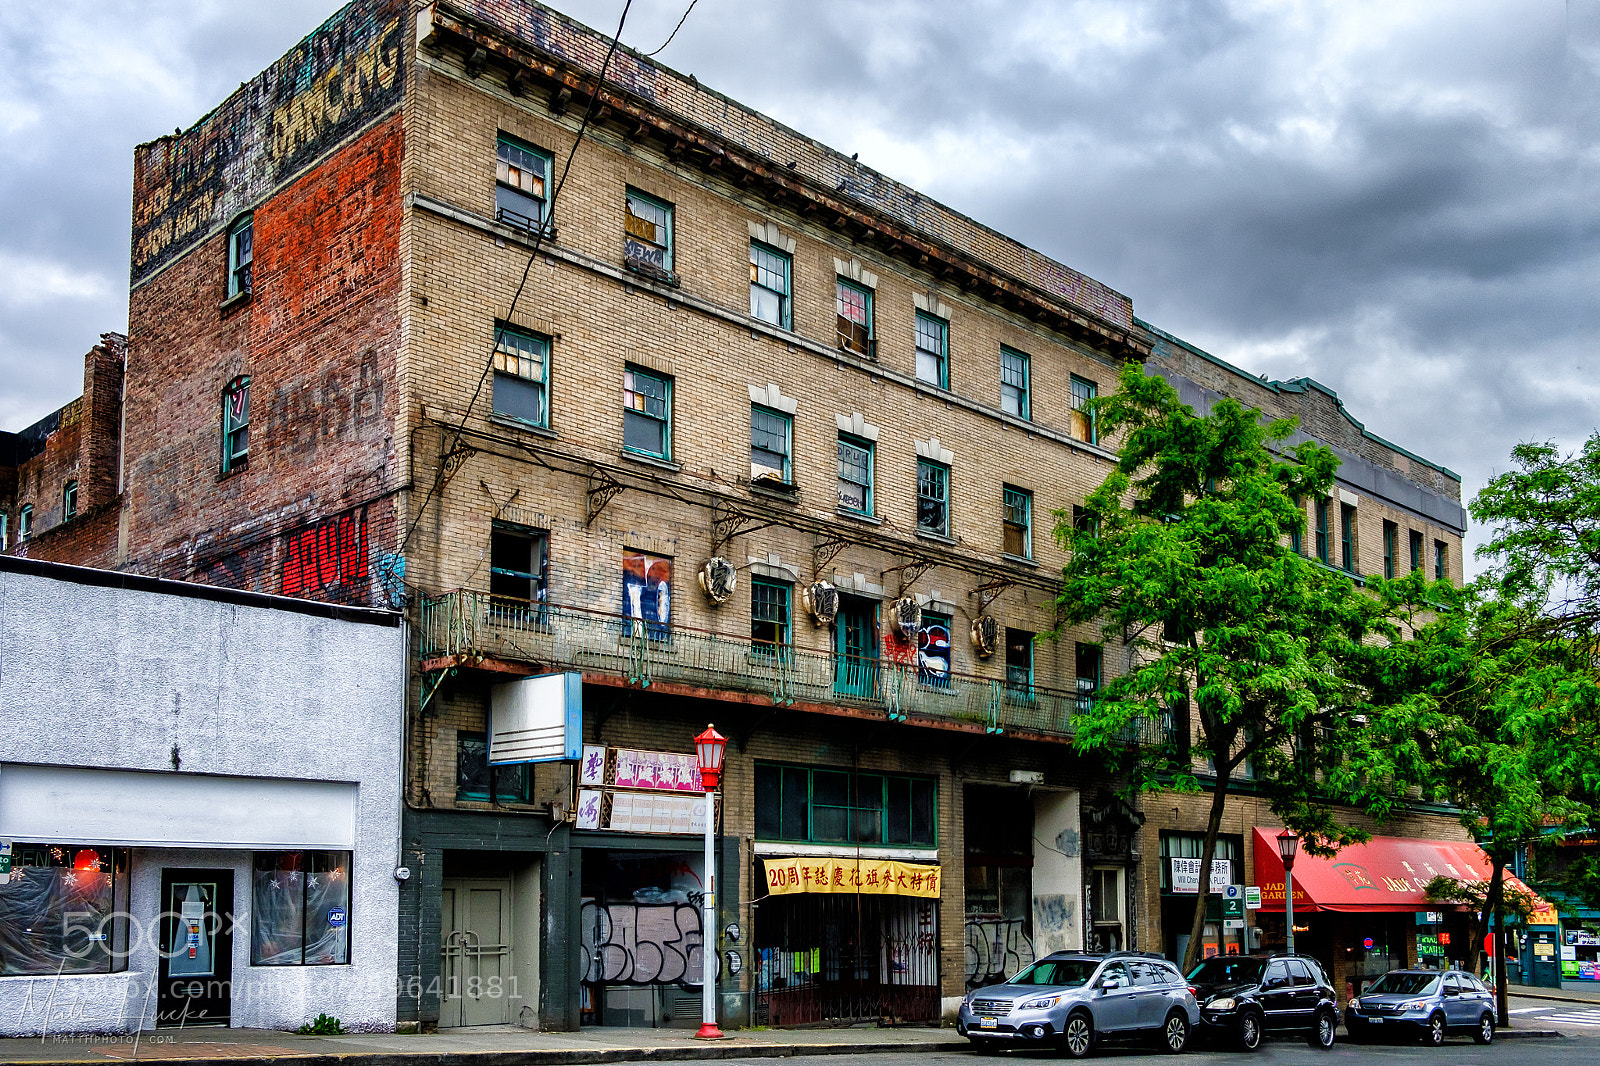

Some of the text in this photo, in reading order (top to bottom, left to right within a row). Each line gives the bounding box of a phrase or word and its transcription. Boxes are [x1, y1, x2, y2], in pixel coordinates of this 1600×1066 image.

[12, 851, 50, 867] PEN
[1214, 877, 1225, 885] PLLC
[1381, 876, 1416, 892] JADE
[1263, 883, 1286, 891] JAD
[1229, 901, 1236, 911] 2
[330, 913, 345, 921] ADT
